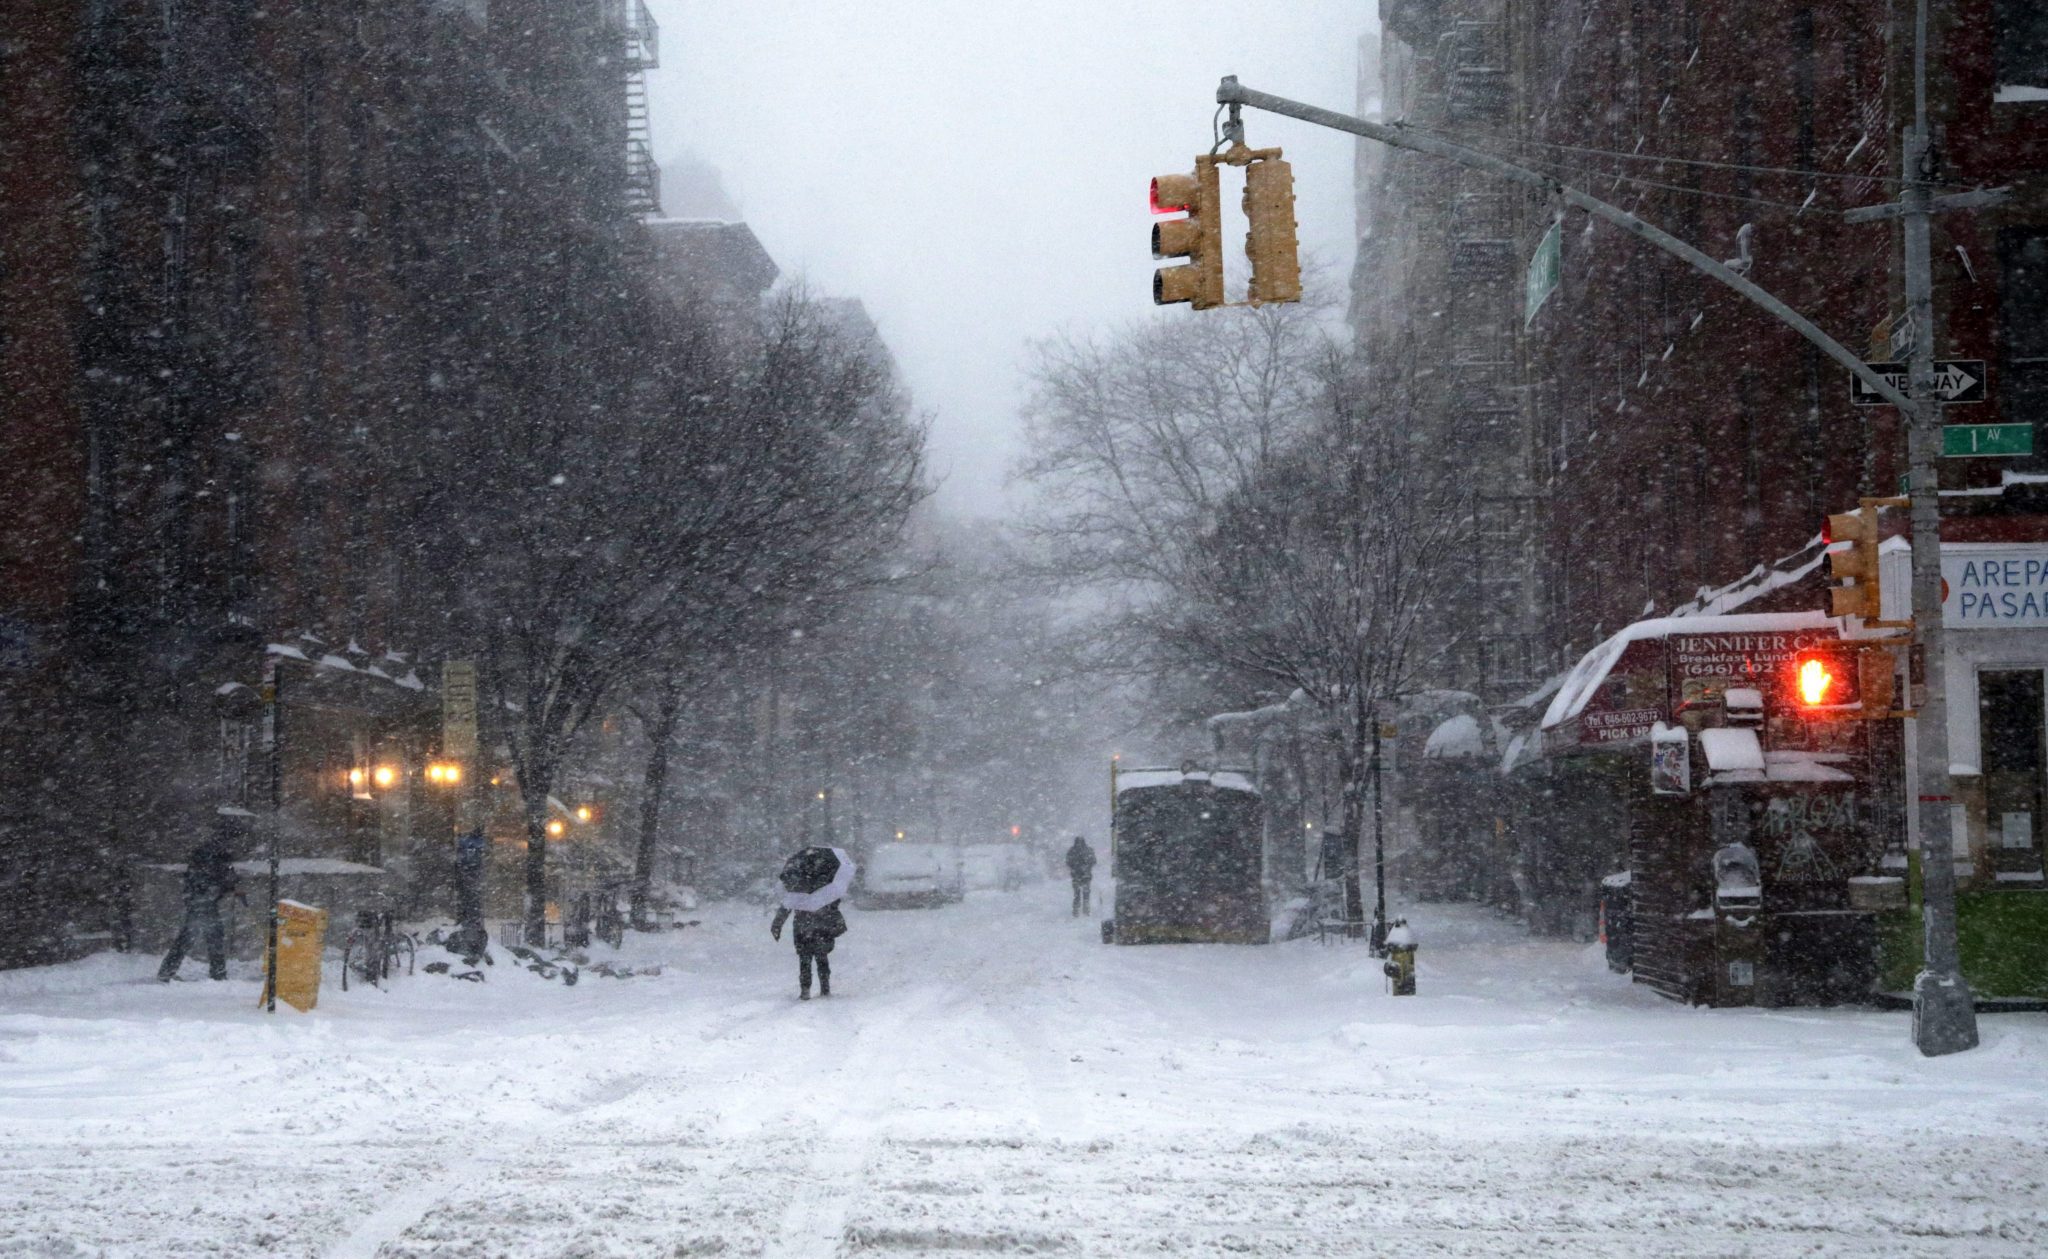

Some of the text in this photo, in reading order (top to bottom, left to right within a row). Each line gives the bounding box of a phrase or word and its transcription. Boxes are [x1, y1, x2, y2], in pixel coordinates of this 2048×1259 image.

[1884, 375, 1909, 390] NE
[1970, 428, 2001, 453] 1 AV
[1676, 635, 1786, 652] JENNIFER
[1684, 663, 1733, 675] (646)
[1599, 726, 1650, 740] PICK UP
